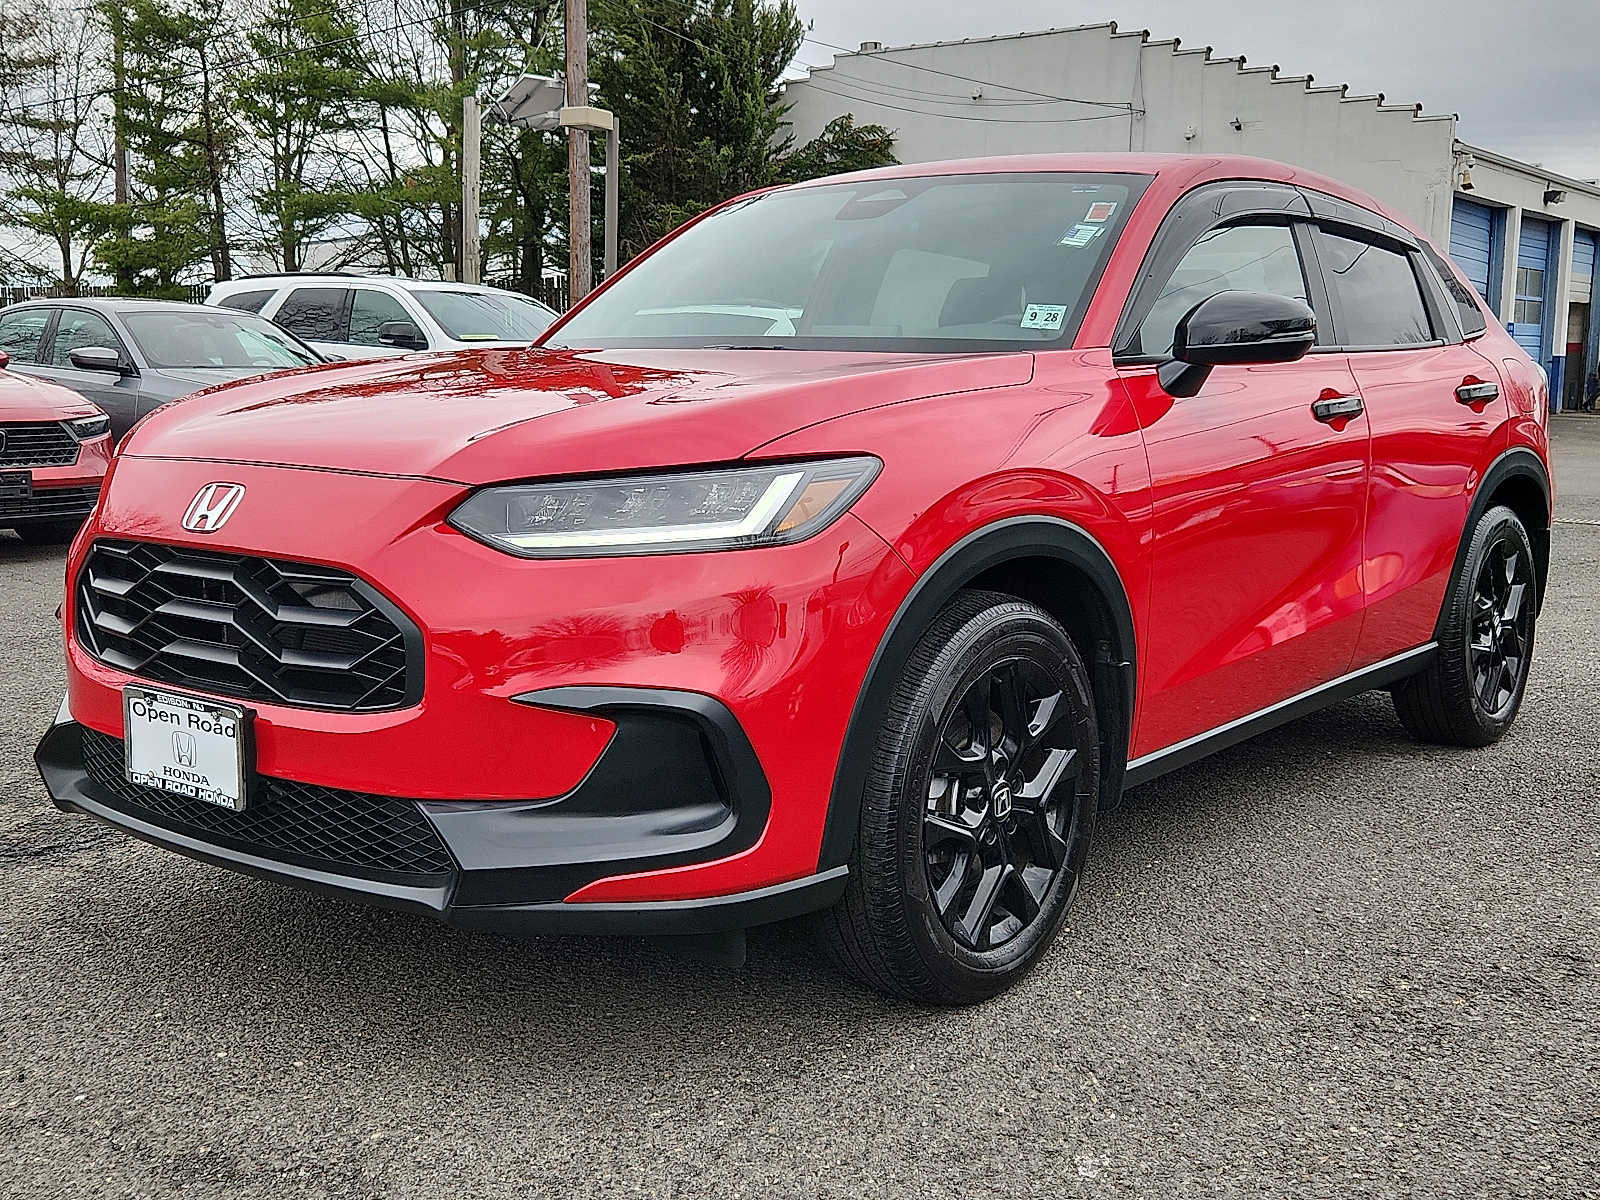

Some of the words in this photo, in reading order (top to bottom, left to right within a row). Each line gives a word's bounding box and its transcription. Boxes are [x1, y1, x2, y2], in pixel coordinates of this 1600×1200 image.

[1029, 312, 1038, 321] 9
[1043, 312, 1059, 323] 28
[192, 702, 205, 712] NJ
[132, 701, 181, 726] Open
[187, 713, 236, 739] Road
[163, 766, 211, 787] HONDA
[132, 773, 163, 789] OPEN
[165, 781, 197, 797] ROAD
[198, 788, 236, 810] HONDA
